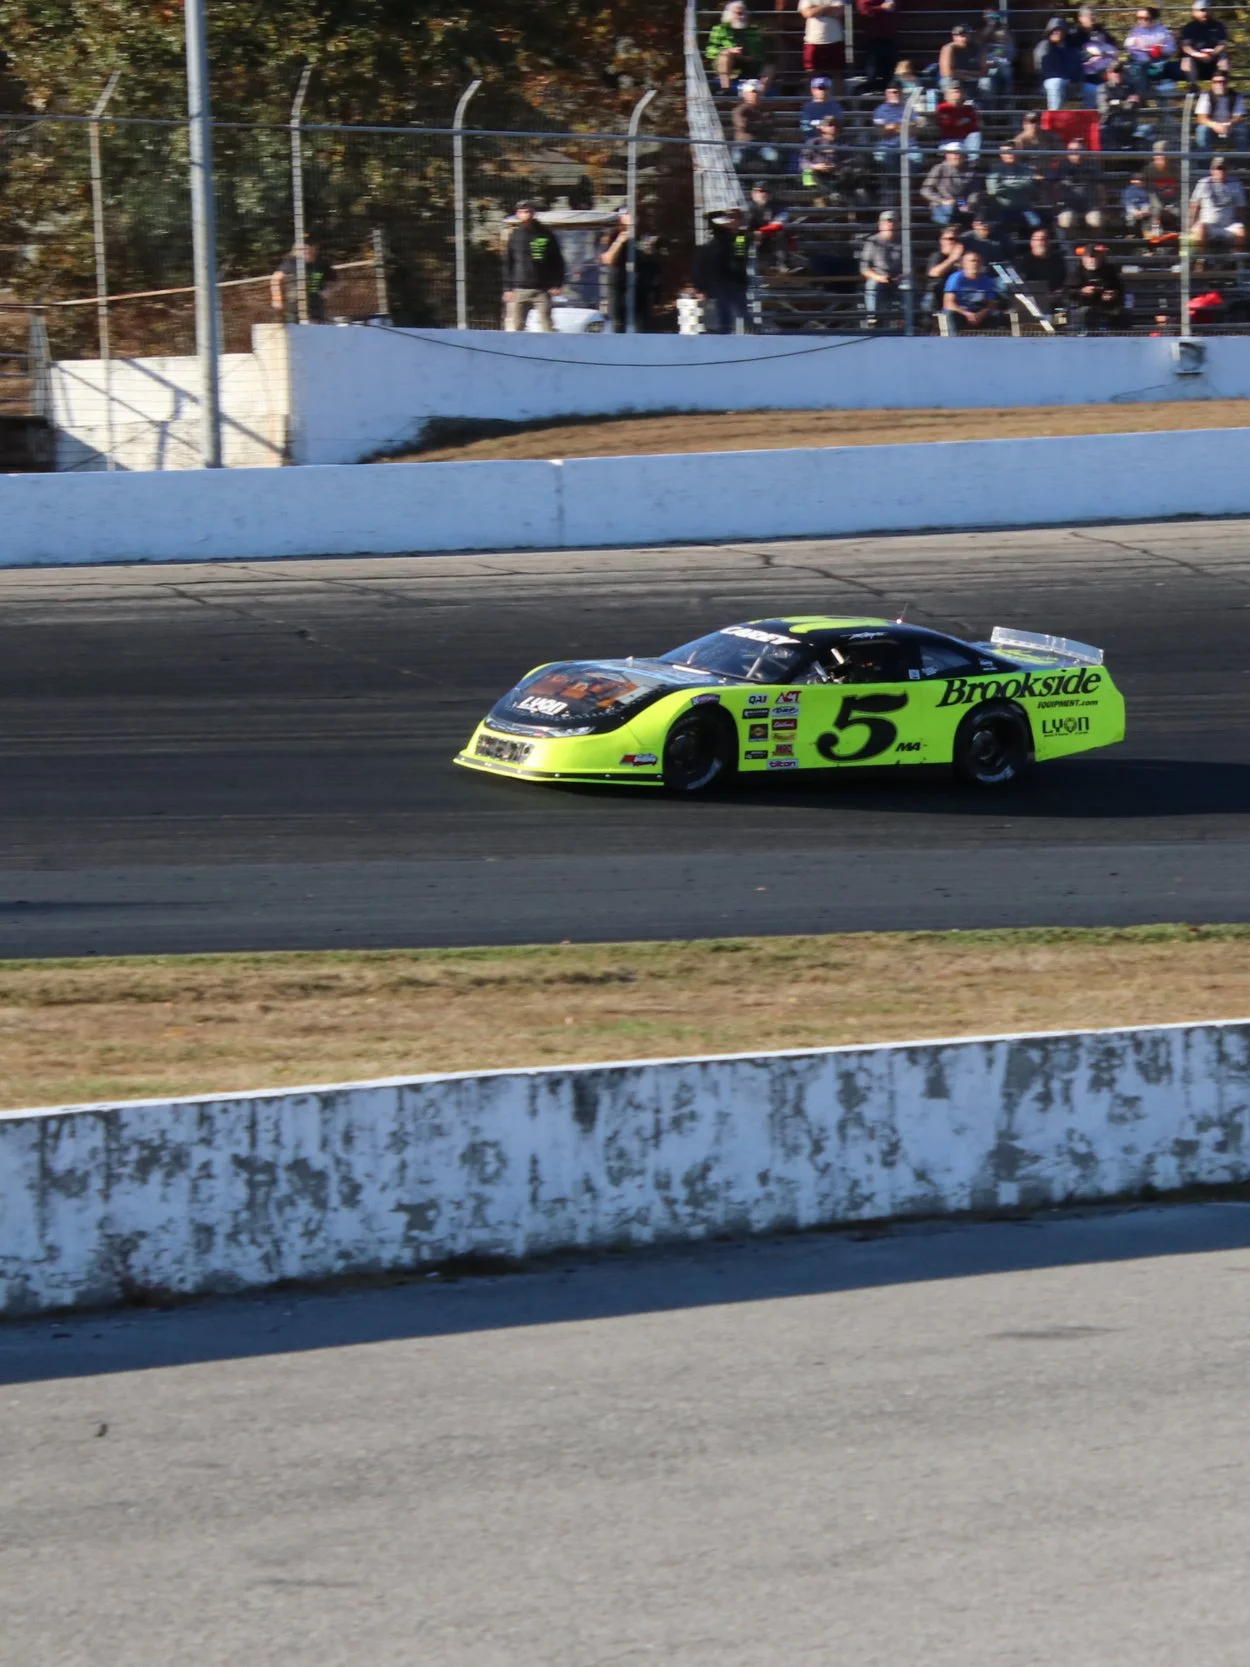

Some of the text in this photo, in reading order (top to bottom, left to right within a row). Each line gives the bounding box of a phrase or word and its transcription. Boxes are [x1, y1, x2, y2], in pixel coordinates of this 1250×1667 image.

[775, 690, 802, 704] ACT
[935, 668, 1102, 708] Brookside
[816, 690, 909, 762] 5
